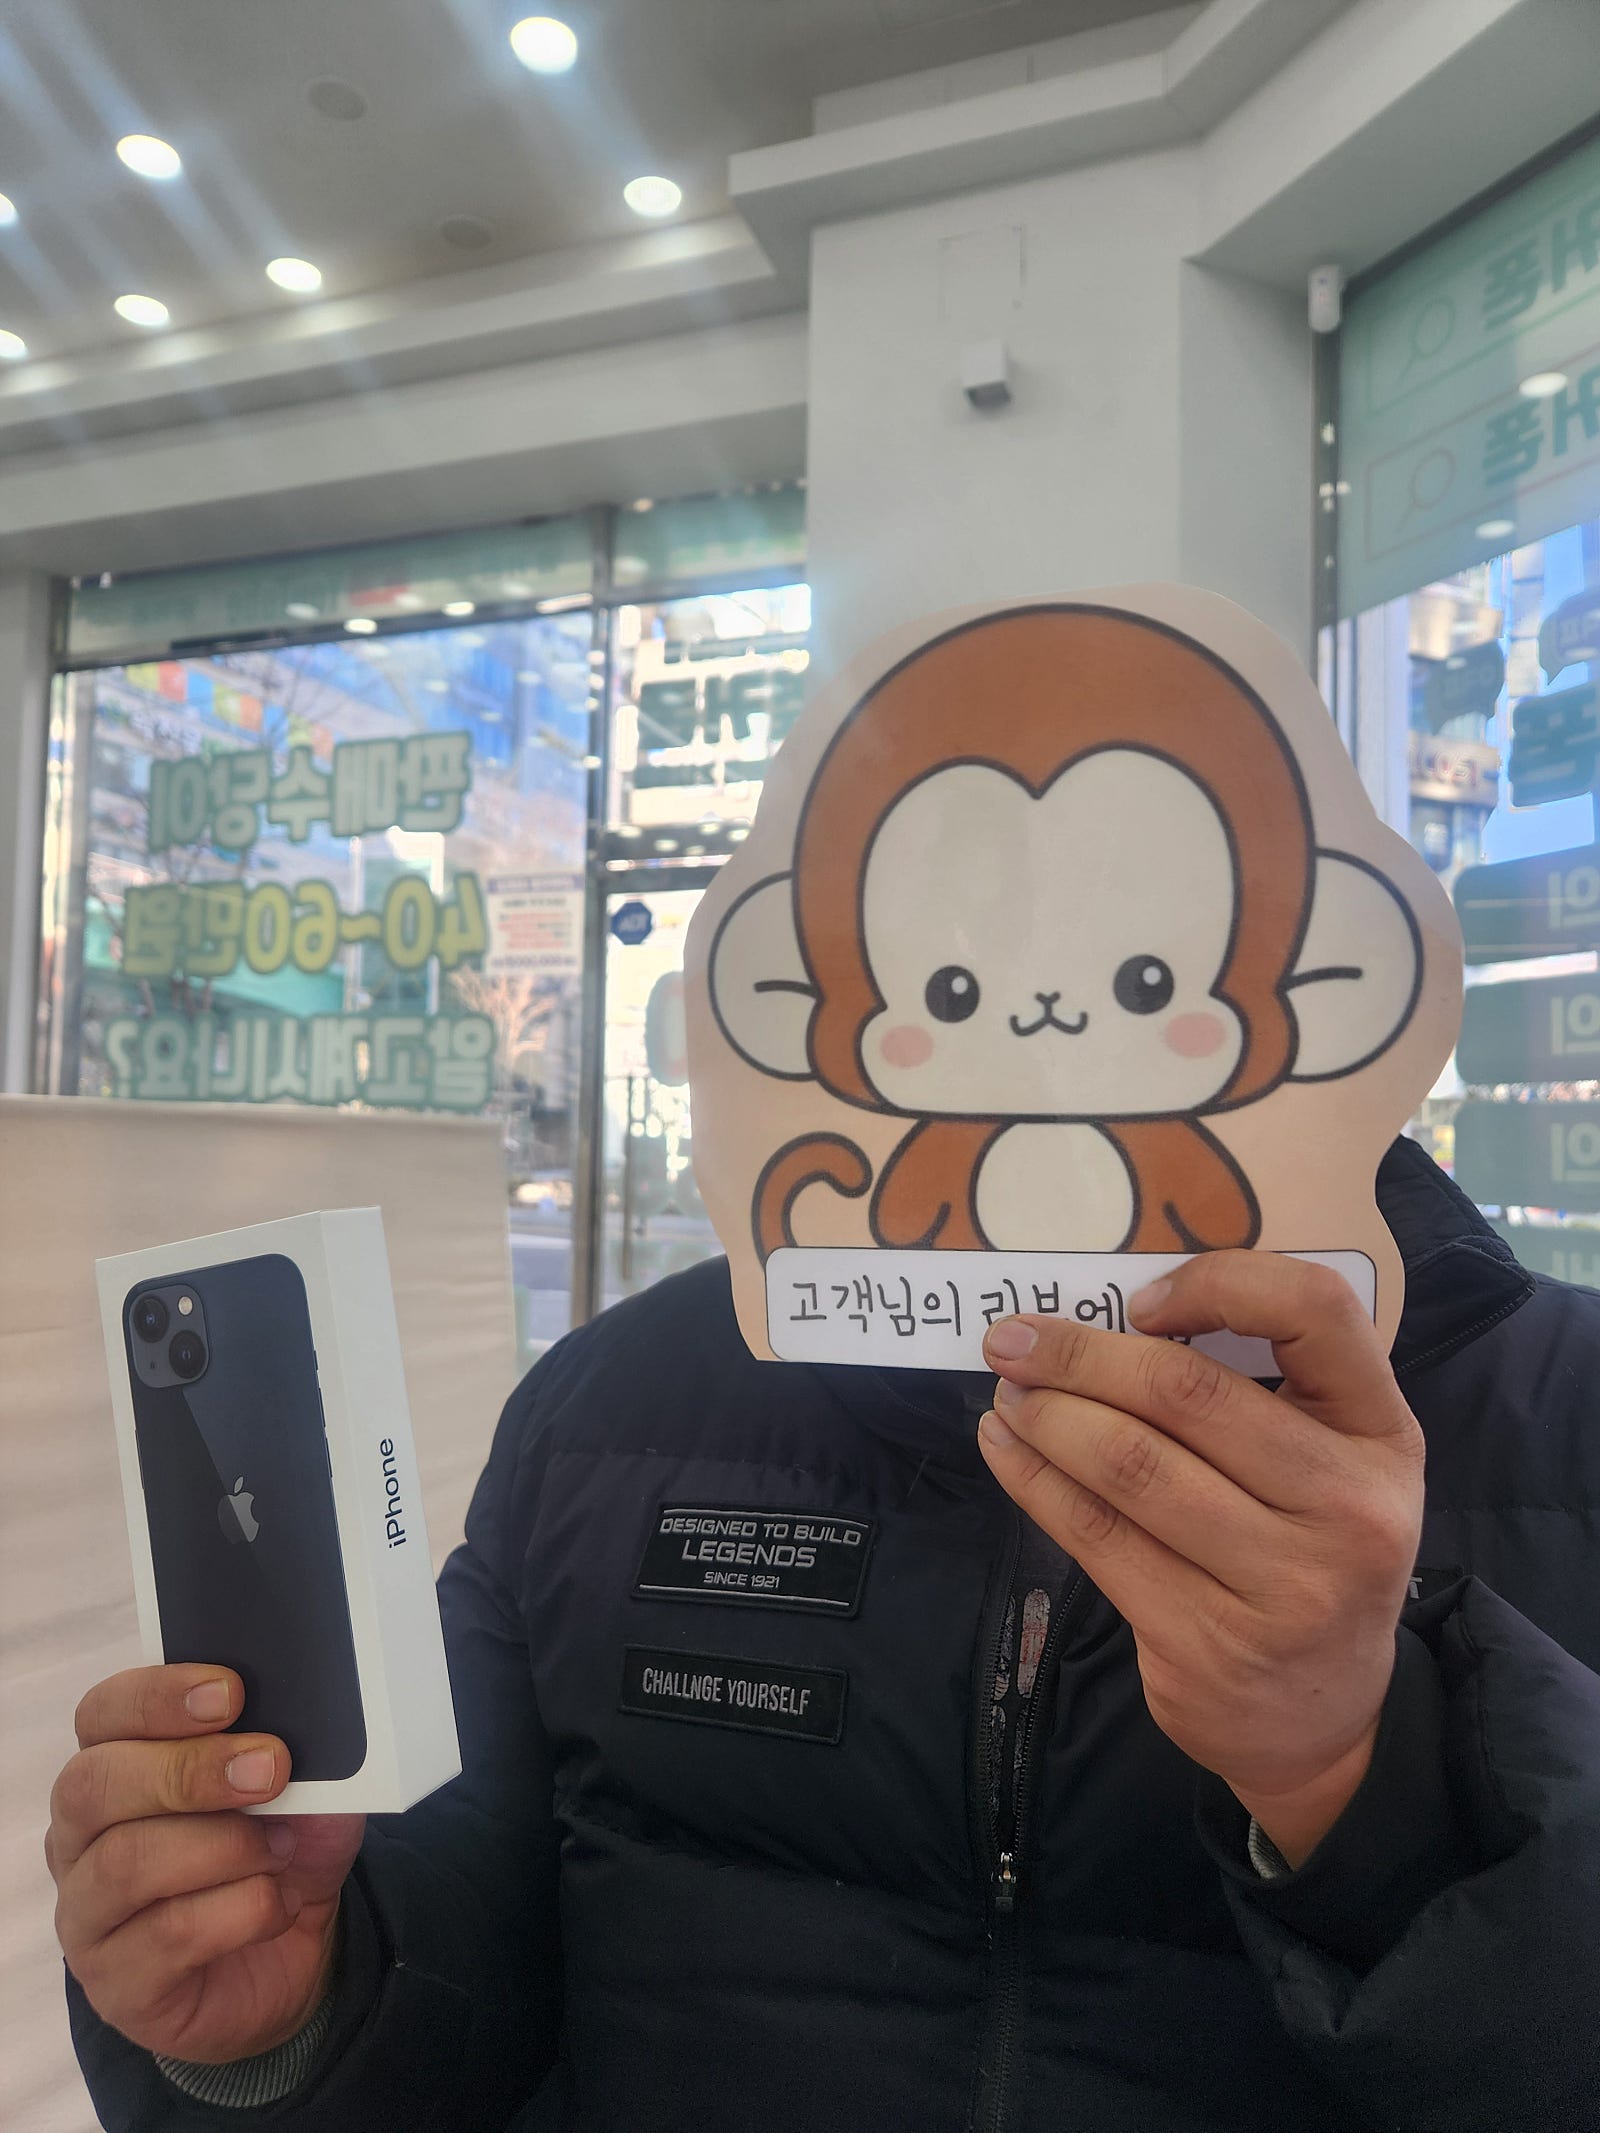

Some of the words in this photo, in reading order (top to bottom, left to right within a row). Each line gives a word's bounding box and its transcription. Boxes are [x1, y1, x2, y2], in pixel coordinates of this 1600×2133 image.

[789, 1275, 962, 1337] 고객님의
[380, 1438, 407, 1549] iPhone
[659, 1518, 757, 1537] DESIGNED
[763, 1523, 789, 1540] TO
[793, 1524, 862, 1546] BUILD
[681, 1539, 817, 1568] LEGENDS
[703, 1571, 749, 1587] SINCE
[750, 1574, 781, 1589] 1921
[642, 1667, 724, 1702] CHALLNGE
[728, 1679, 812, 1716] YOURSELF
